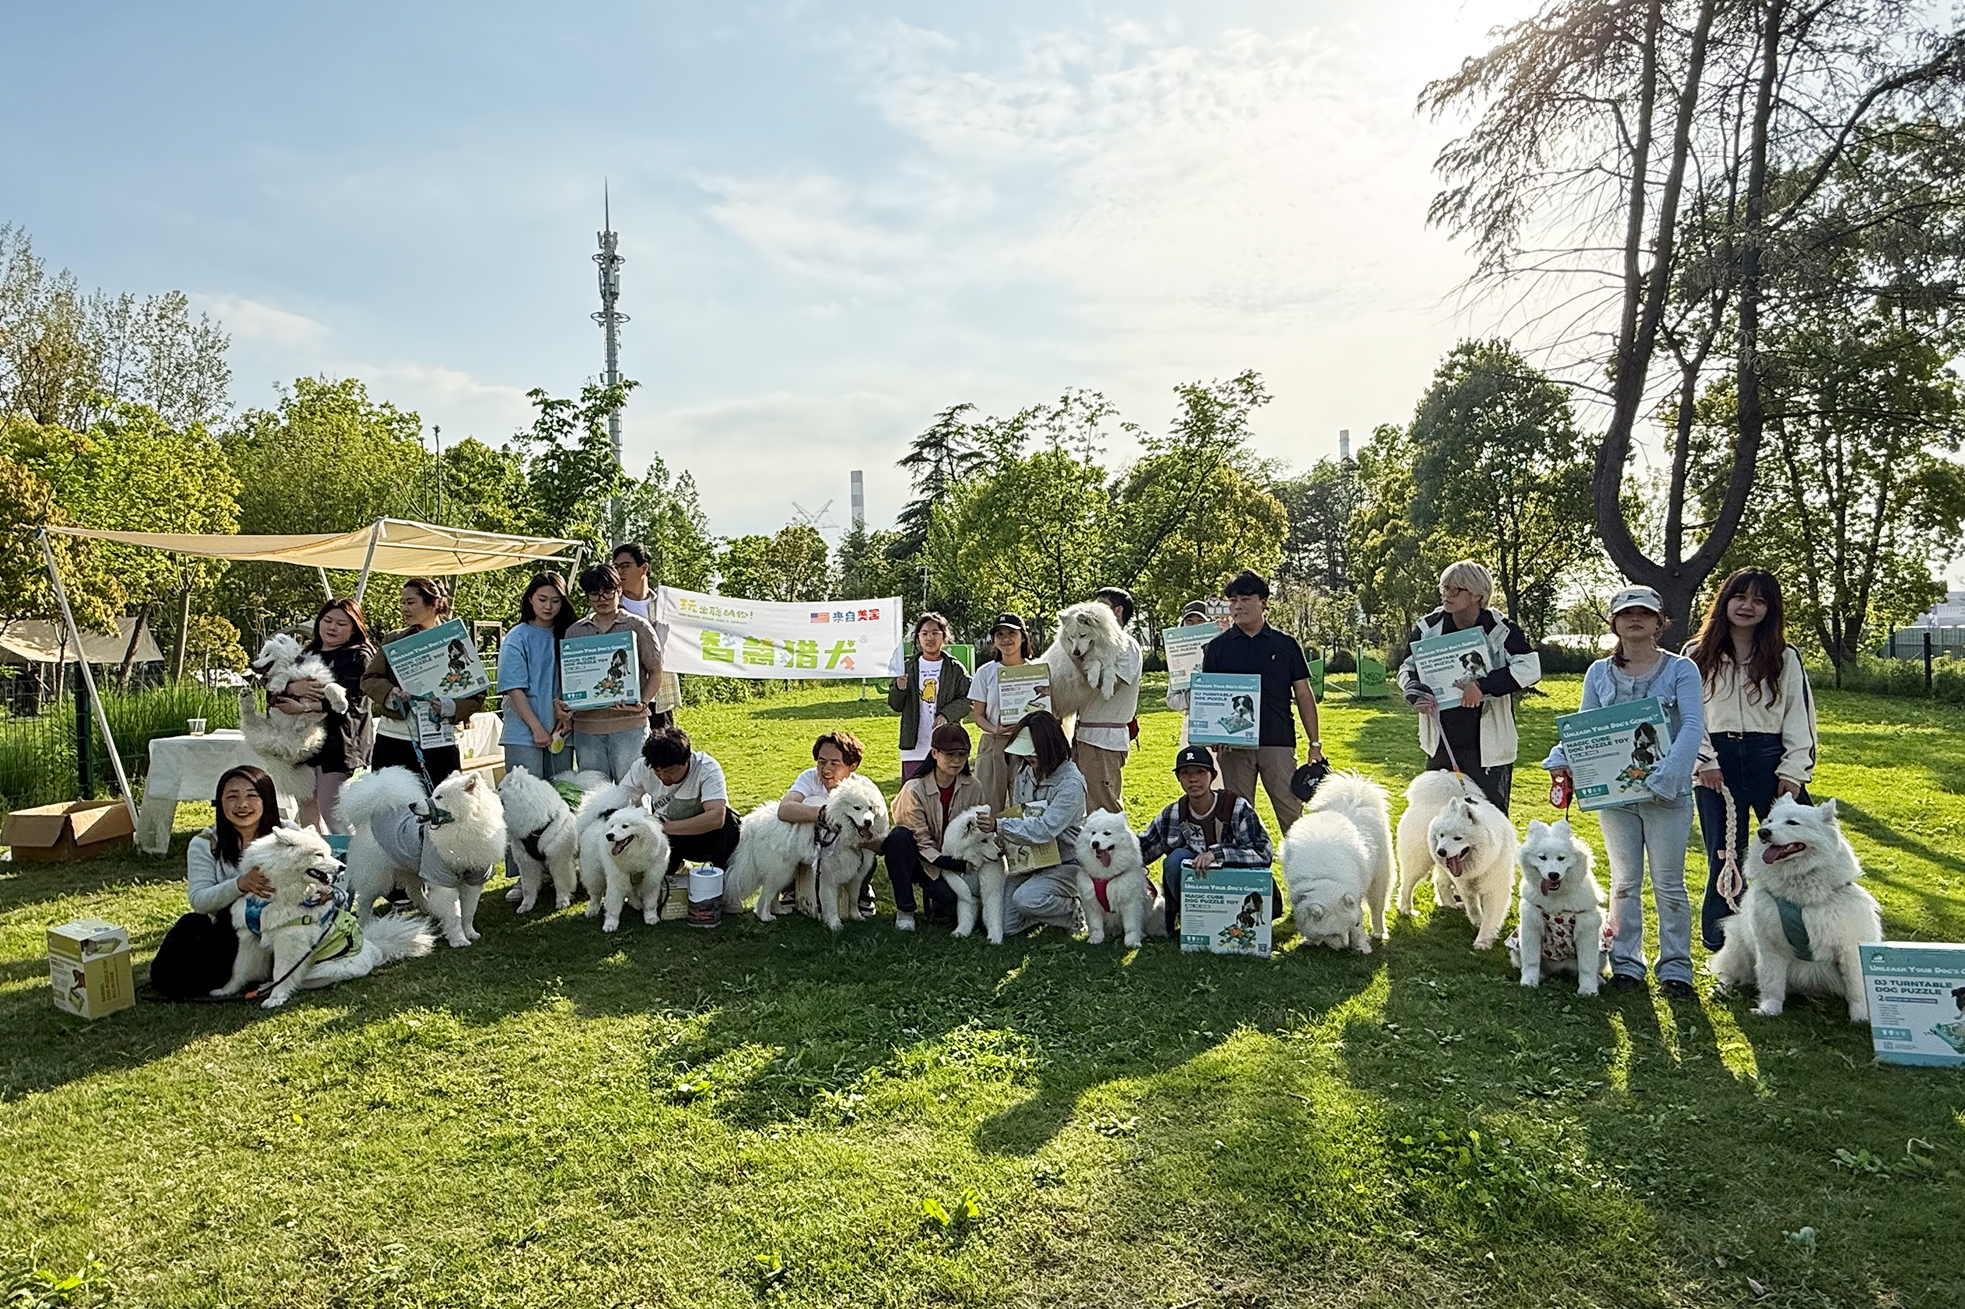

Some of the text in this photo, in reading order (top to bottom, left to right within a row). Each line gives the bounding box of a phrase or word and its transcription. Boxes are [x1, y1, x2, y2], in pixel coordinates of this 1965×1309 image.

[833, 609, 880, 623] 来自美国
[700, 630, 856, 670] 智慧猎犬
[1567, 739, 1590, 748] MAGIC
[1568, 737, 1629, 754] DOG PUZZLE TOY
[1186, 752, 1195, 760] R
[1890, 980, 1952, 988] TURNTABLE
[1901, 987, 1942, 995] PUZZLE
